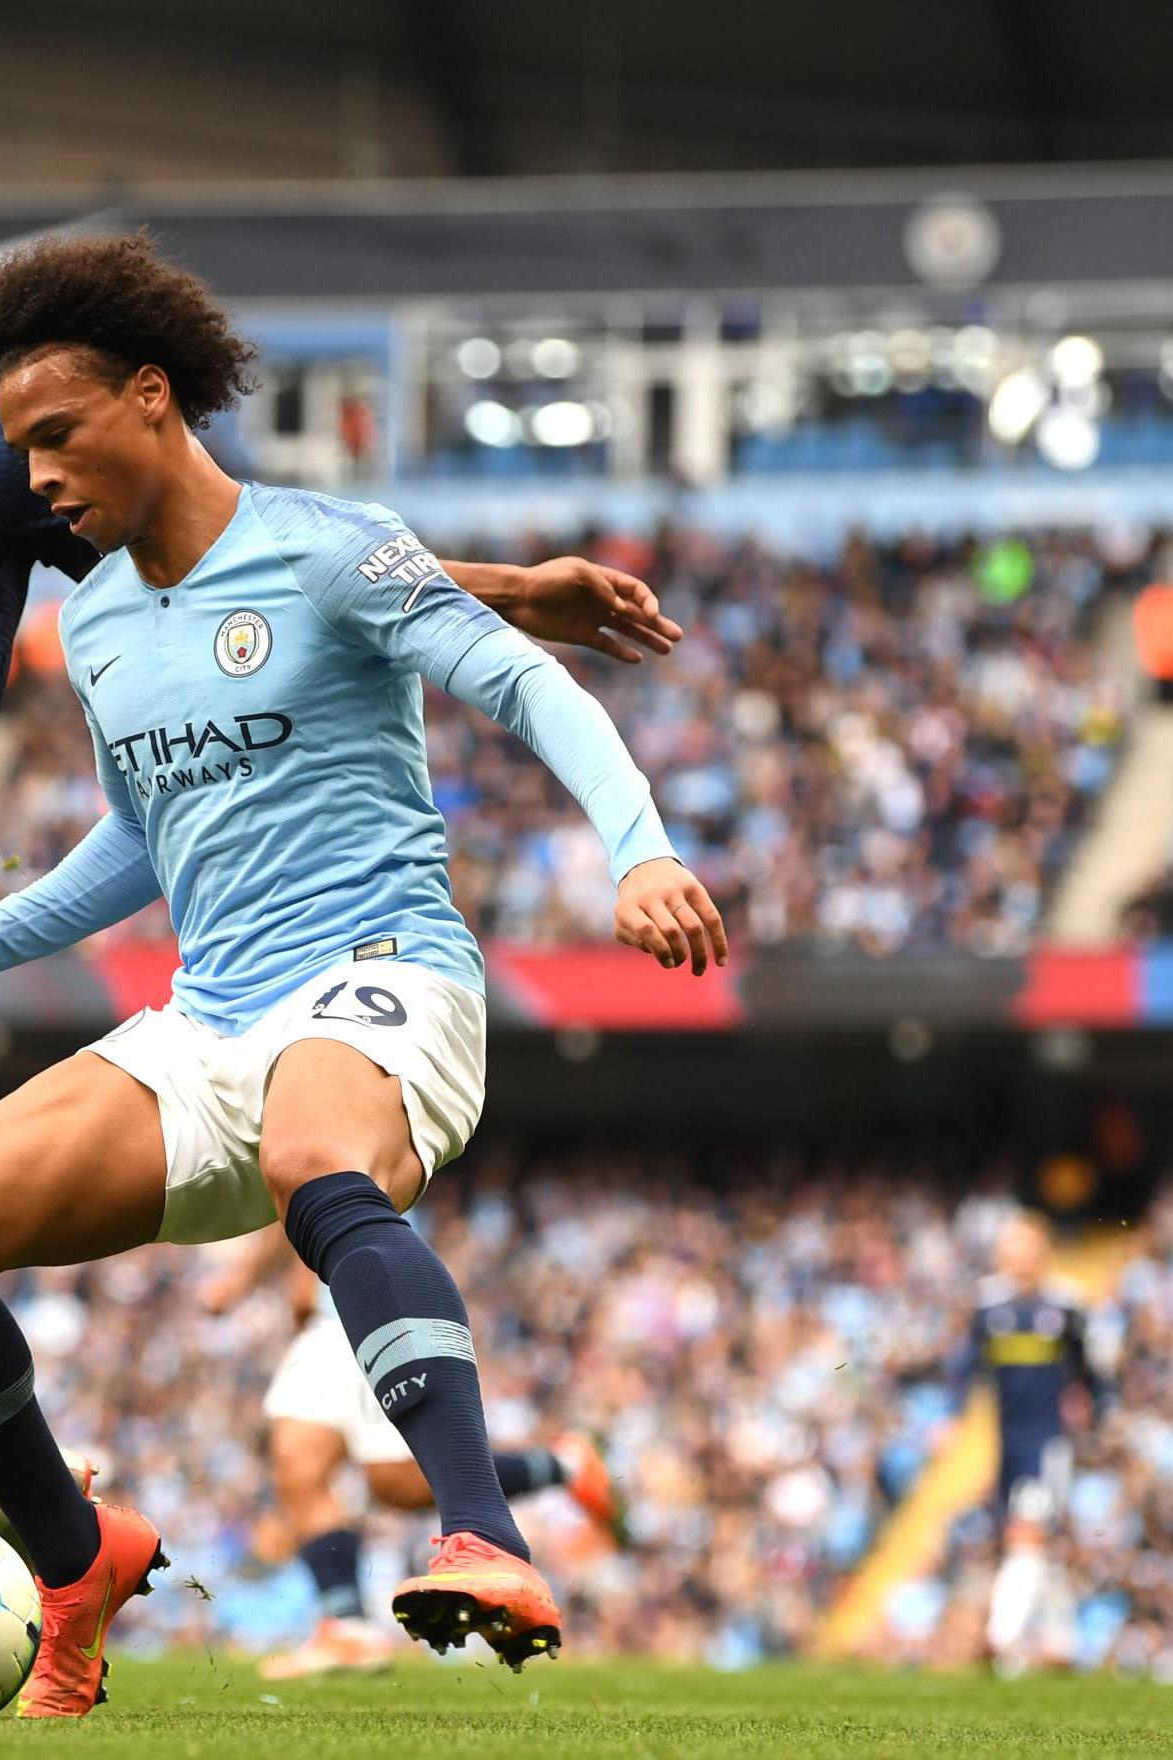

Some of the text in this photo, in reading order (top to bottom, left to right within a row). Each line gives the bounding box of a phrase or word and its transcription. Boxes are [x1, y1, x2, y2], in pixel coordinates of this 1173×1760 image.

[357, 535, 426, 584] NEXE
[389, 551, 439, 585] TIR
[220, 613, 264, 637] MANCHESTER
[234, 663, 252, 673] CITY
[136, 757, 253, 799] AIRWAYS
[312, 981, 407, 1027] 19
[381, 1372, 428, 1410] CITY
